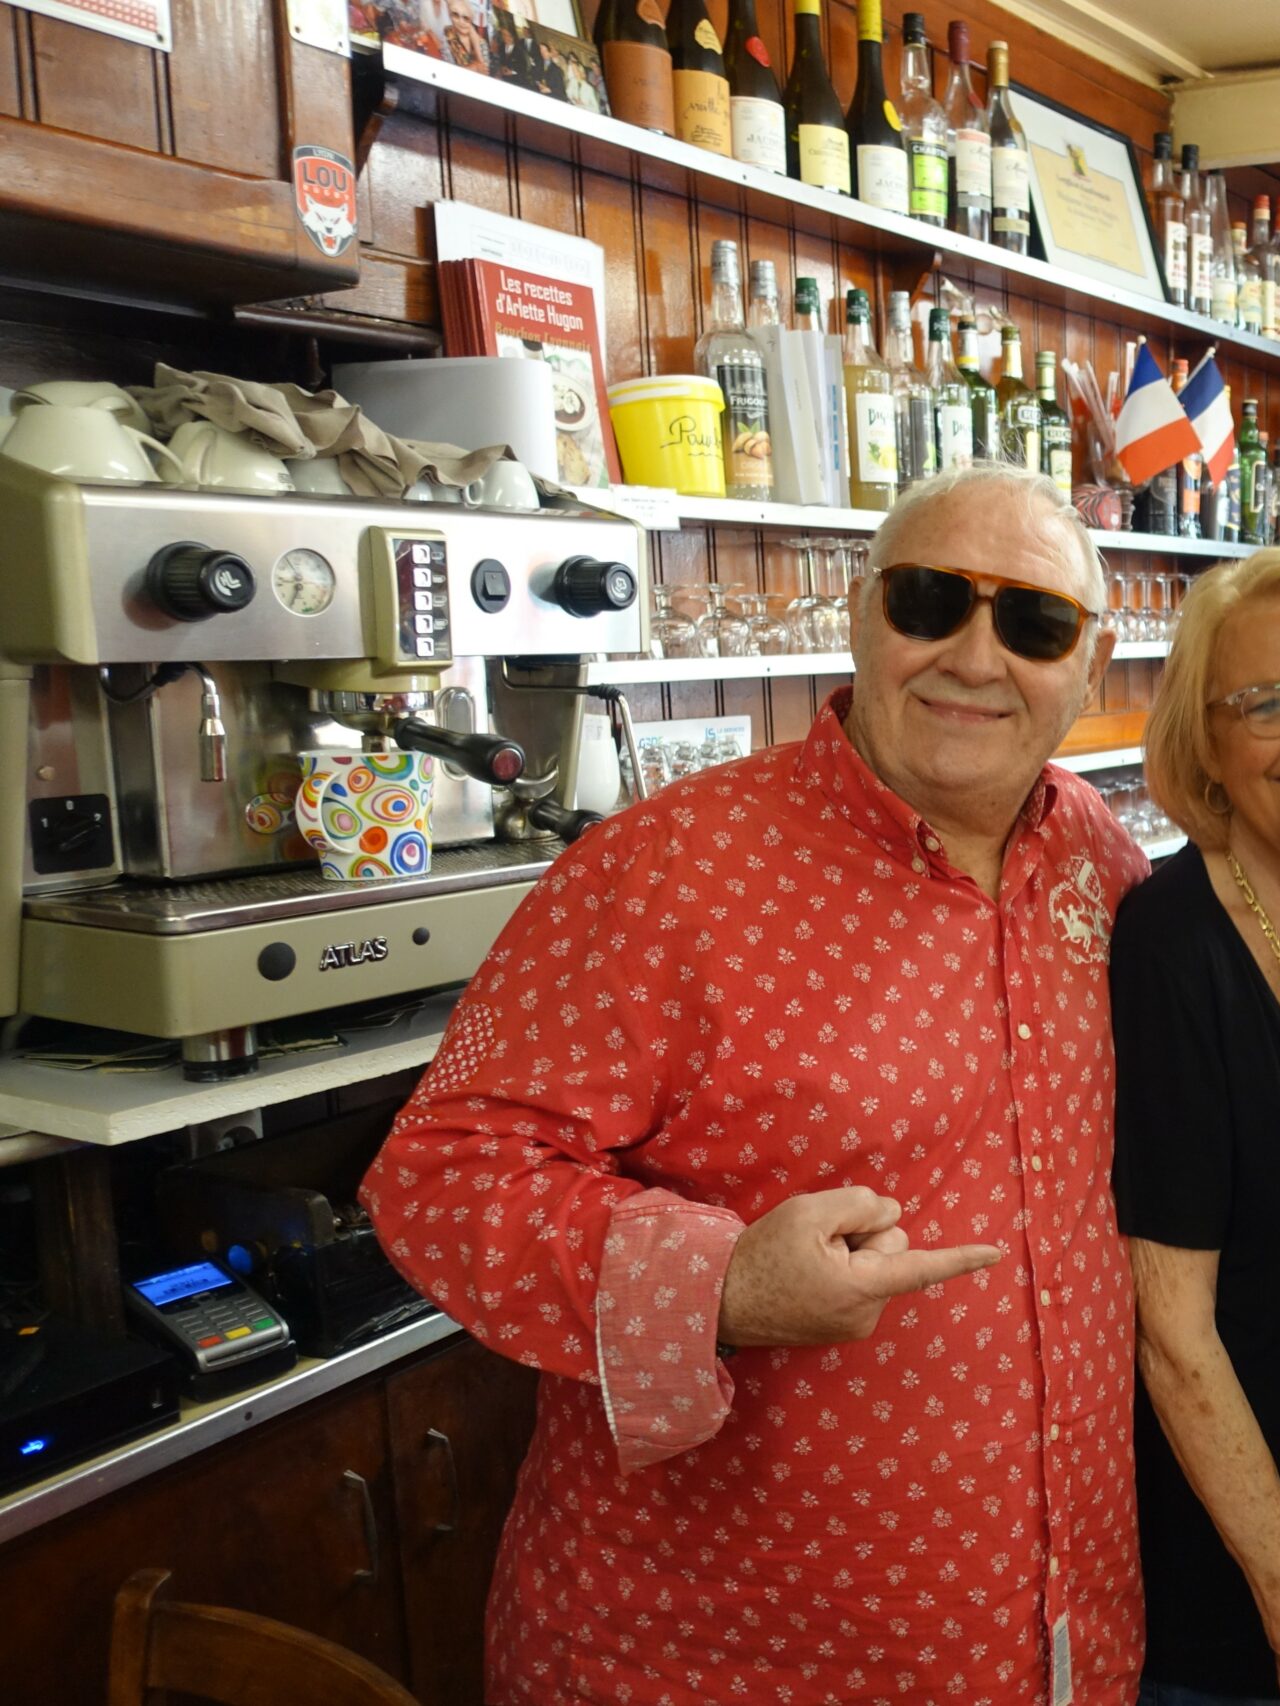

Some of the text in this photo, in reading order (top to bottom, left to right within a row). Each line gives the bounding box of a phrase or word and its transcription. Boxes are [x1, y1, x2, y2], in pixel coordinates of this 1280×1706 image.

[302, 161, 347, 192] LOU
[499, 270, 574, 306] Les recettes
[495, 292, 584, 332] d'Arlette Hugon
[40, 816, 49, 829] 1
[319, 935, 388, 971] ATLAS
